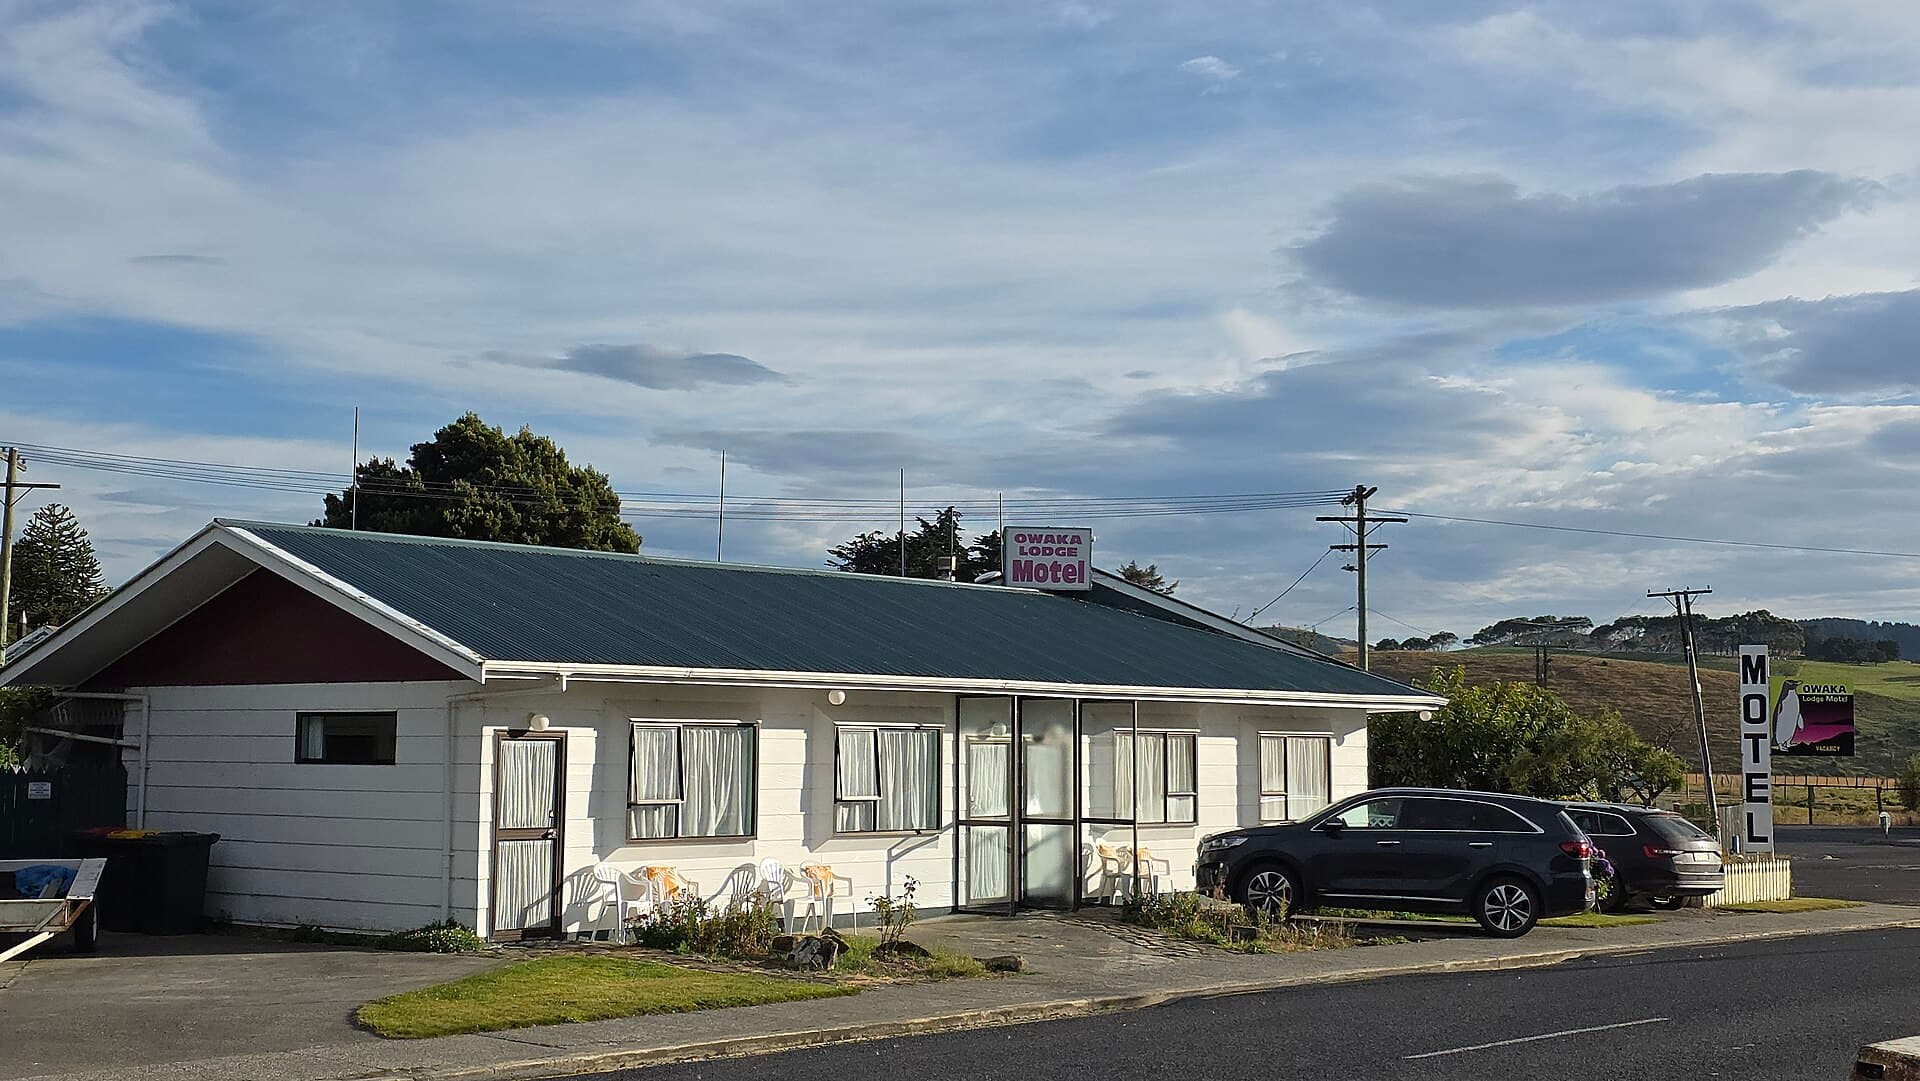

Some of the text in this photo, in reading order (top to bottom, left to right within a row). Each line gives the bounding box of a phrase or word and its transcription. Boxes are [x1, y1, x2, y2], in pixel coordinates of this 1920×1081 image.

[1014, 533, 1082, 544] OWAKA
[1019, 546, 1078, 557] LODGE
[1012, 560, 1085, 583] Motel
[1803, 684, 1847, 693] OWAKA
[1802, 695, 1848, 703] Lodge Motel
[1741, 654, 1769, 843] MOTEL
